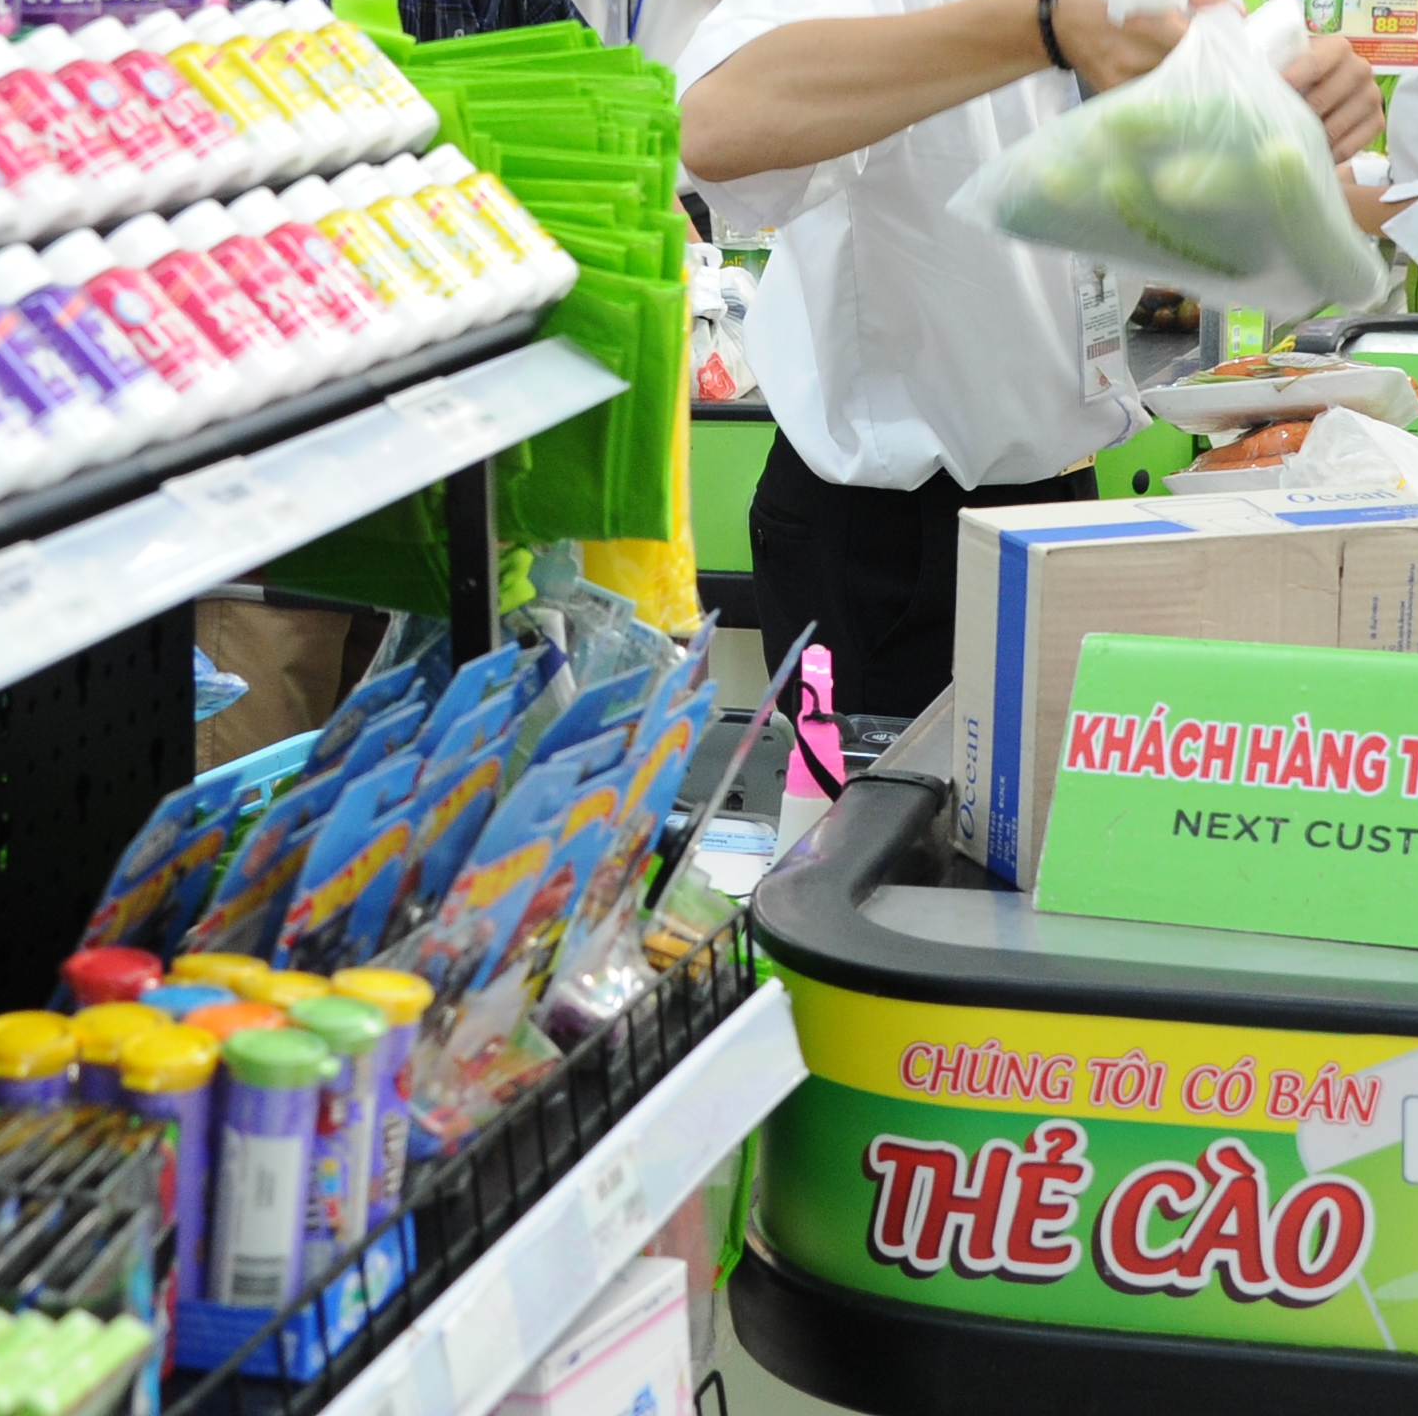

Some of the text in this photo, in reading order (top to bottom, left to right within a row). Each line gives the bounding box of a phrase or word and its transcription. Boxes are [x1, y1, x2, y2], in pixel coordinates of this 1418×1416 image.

[1287, 489, 1397, 504] Ocean
[959, 717, 980, 840] Ocean
[1063, 703, 1239, 784] KHÁCH
[1242, 710, 1389, 795] HÀNG
[1173, 809, 1290, 844] NEXT
[899, 1038, 1381, 1126] CHÚNG TÔI CÓ BÁN
[865, 1118, 1375, 1306] THẺ CÀO
